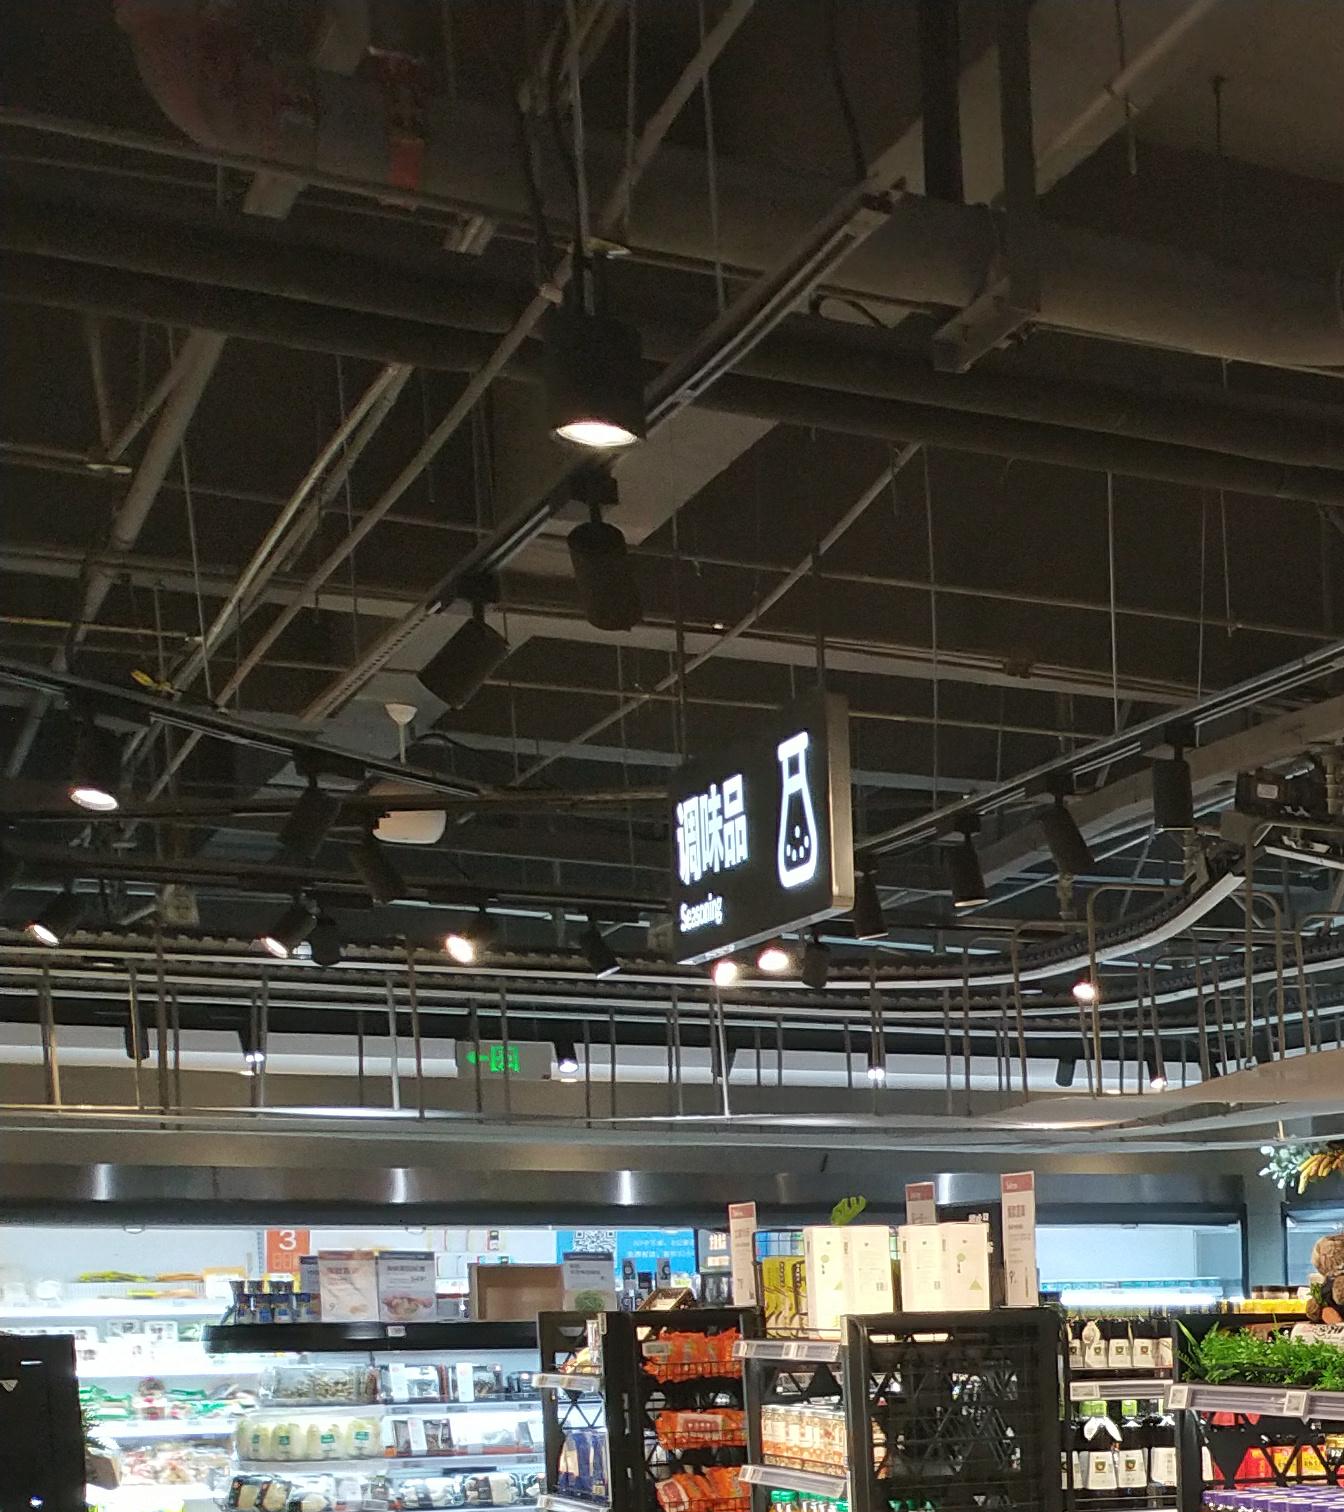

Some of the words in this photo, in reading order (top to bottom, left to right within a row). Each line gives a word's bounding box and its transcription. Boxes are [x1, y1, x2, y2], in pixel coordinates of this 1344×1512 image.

[677, 774, 749, 885] 调味品
[680, 893, 723, 932] Seasoning
